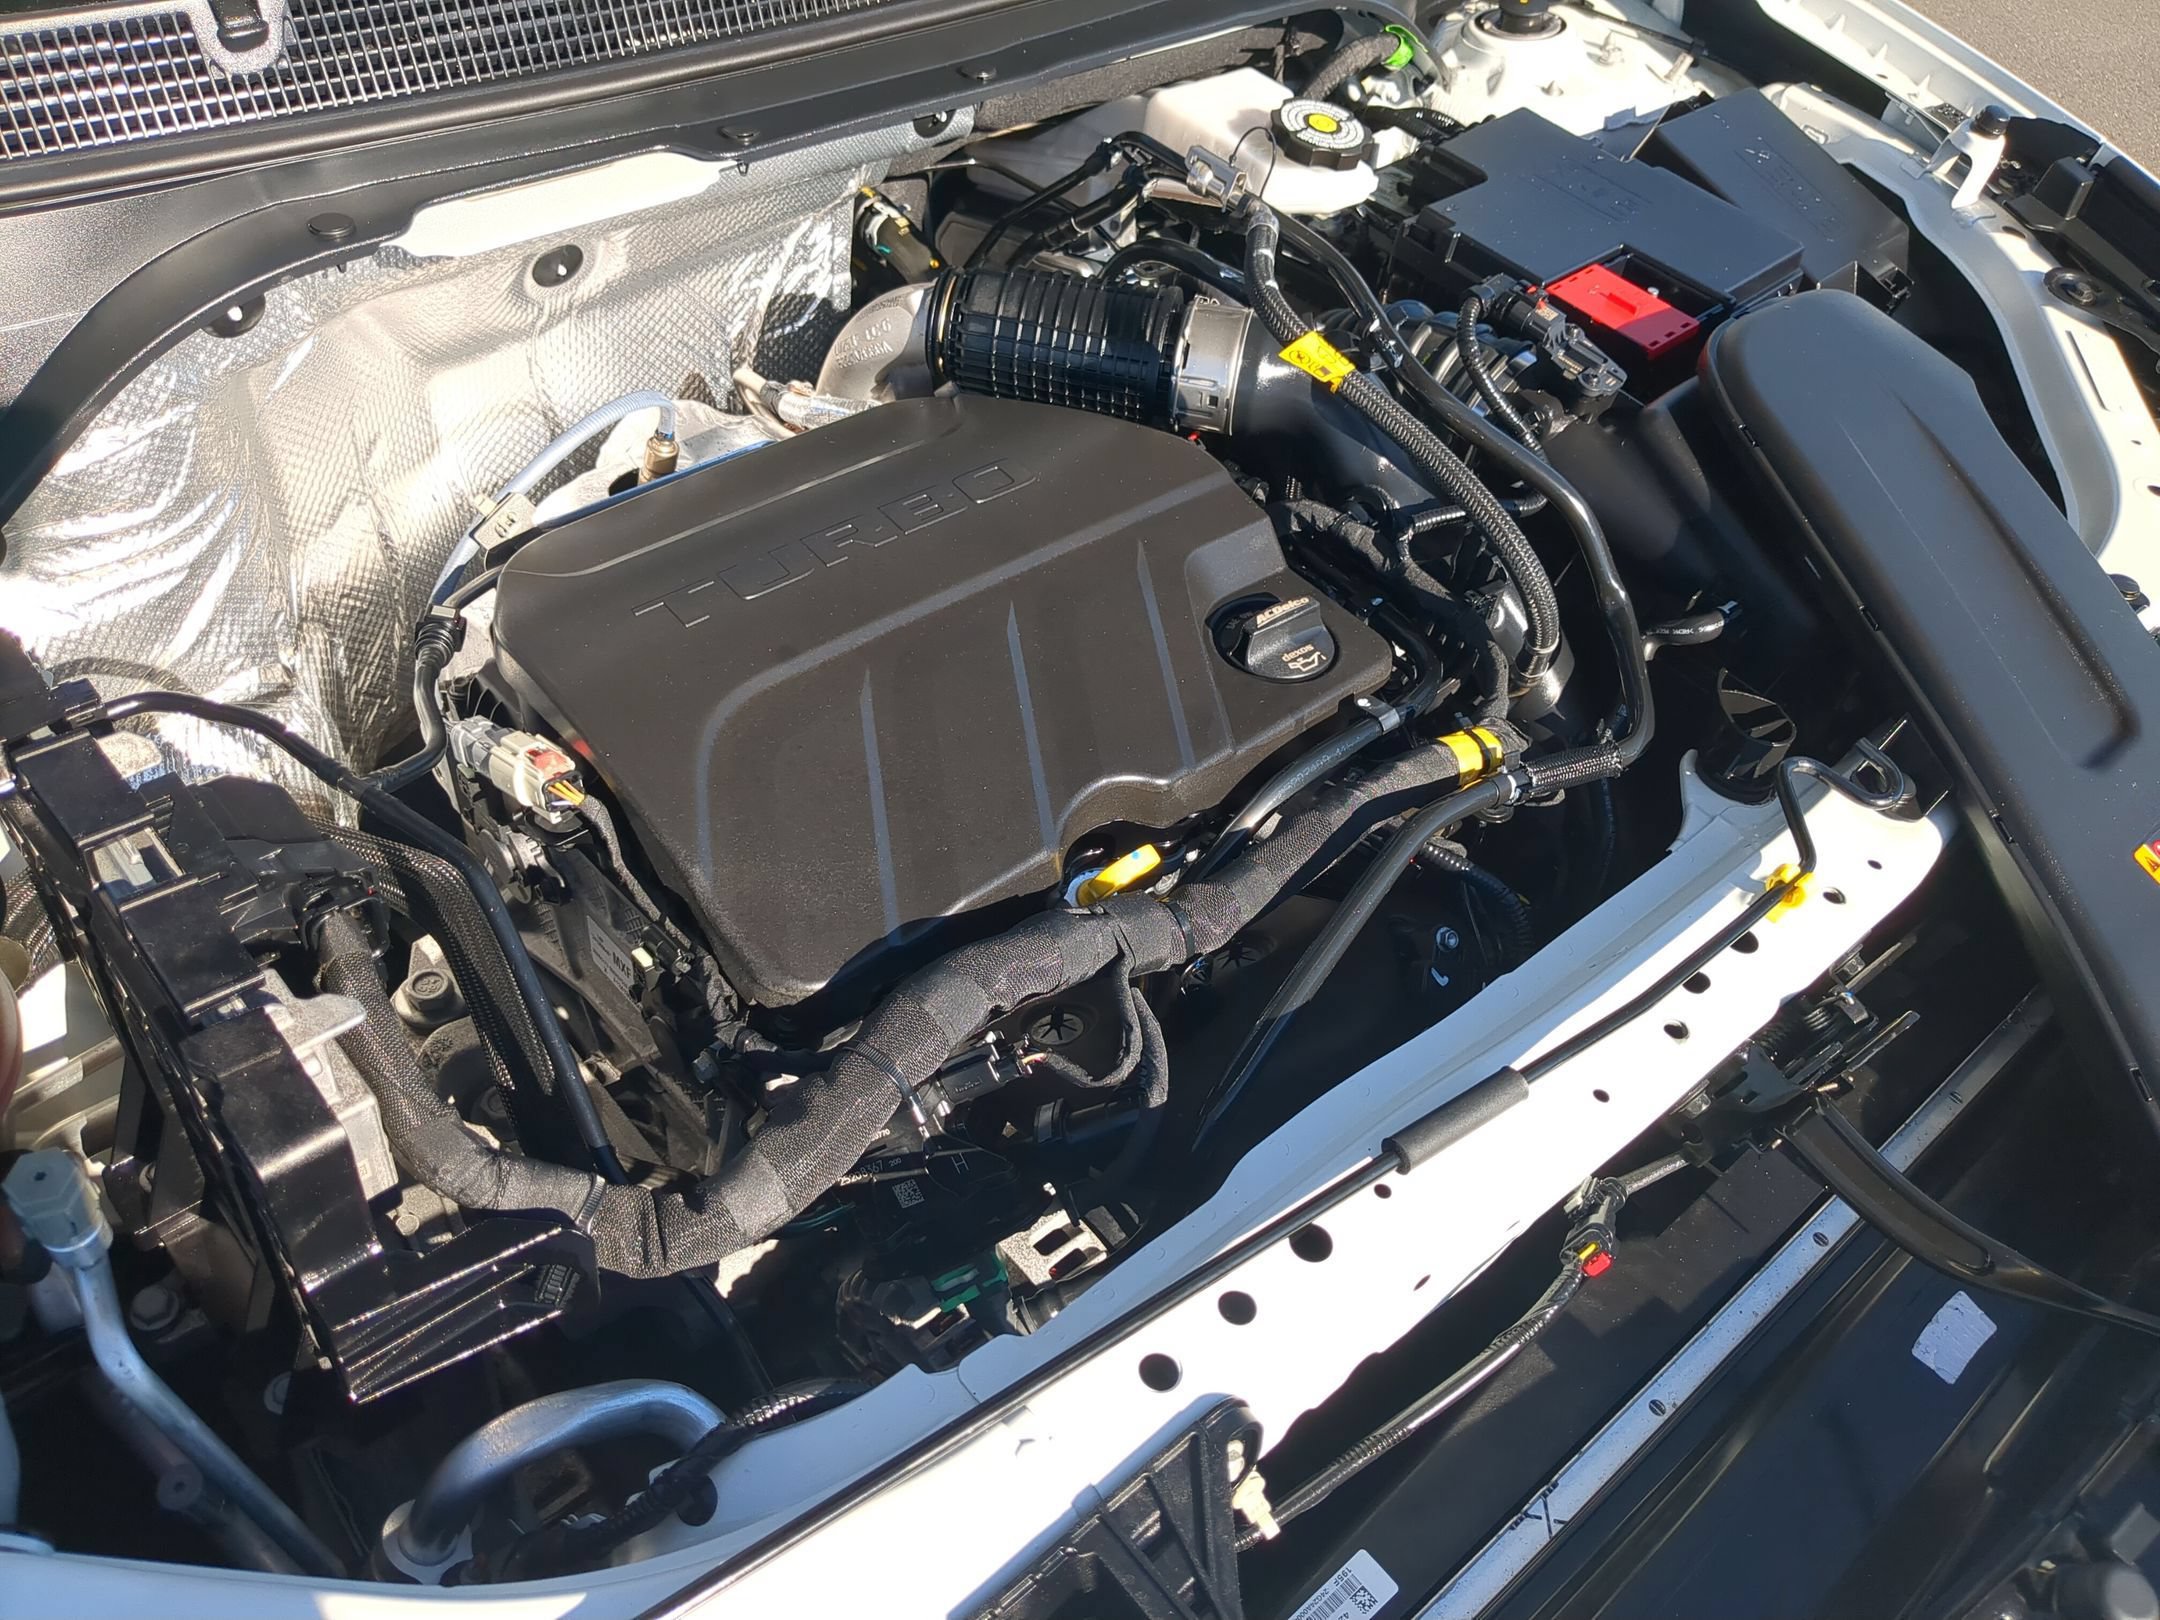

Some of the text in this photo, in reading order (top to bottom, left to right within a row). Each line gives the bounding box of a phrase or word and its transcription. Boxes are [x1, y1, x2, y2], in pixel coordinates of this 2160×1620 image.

[631, 457, 1037, 628] TURBO
[1256, 597, 1310, 626] ACDelco
[1281, 644, 1315, 662] dexos
